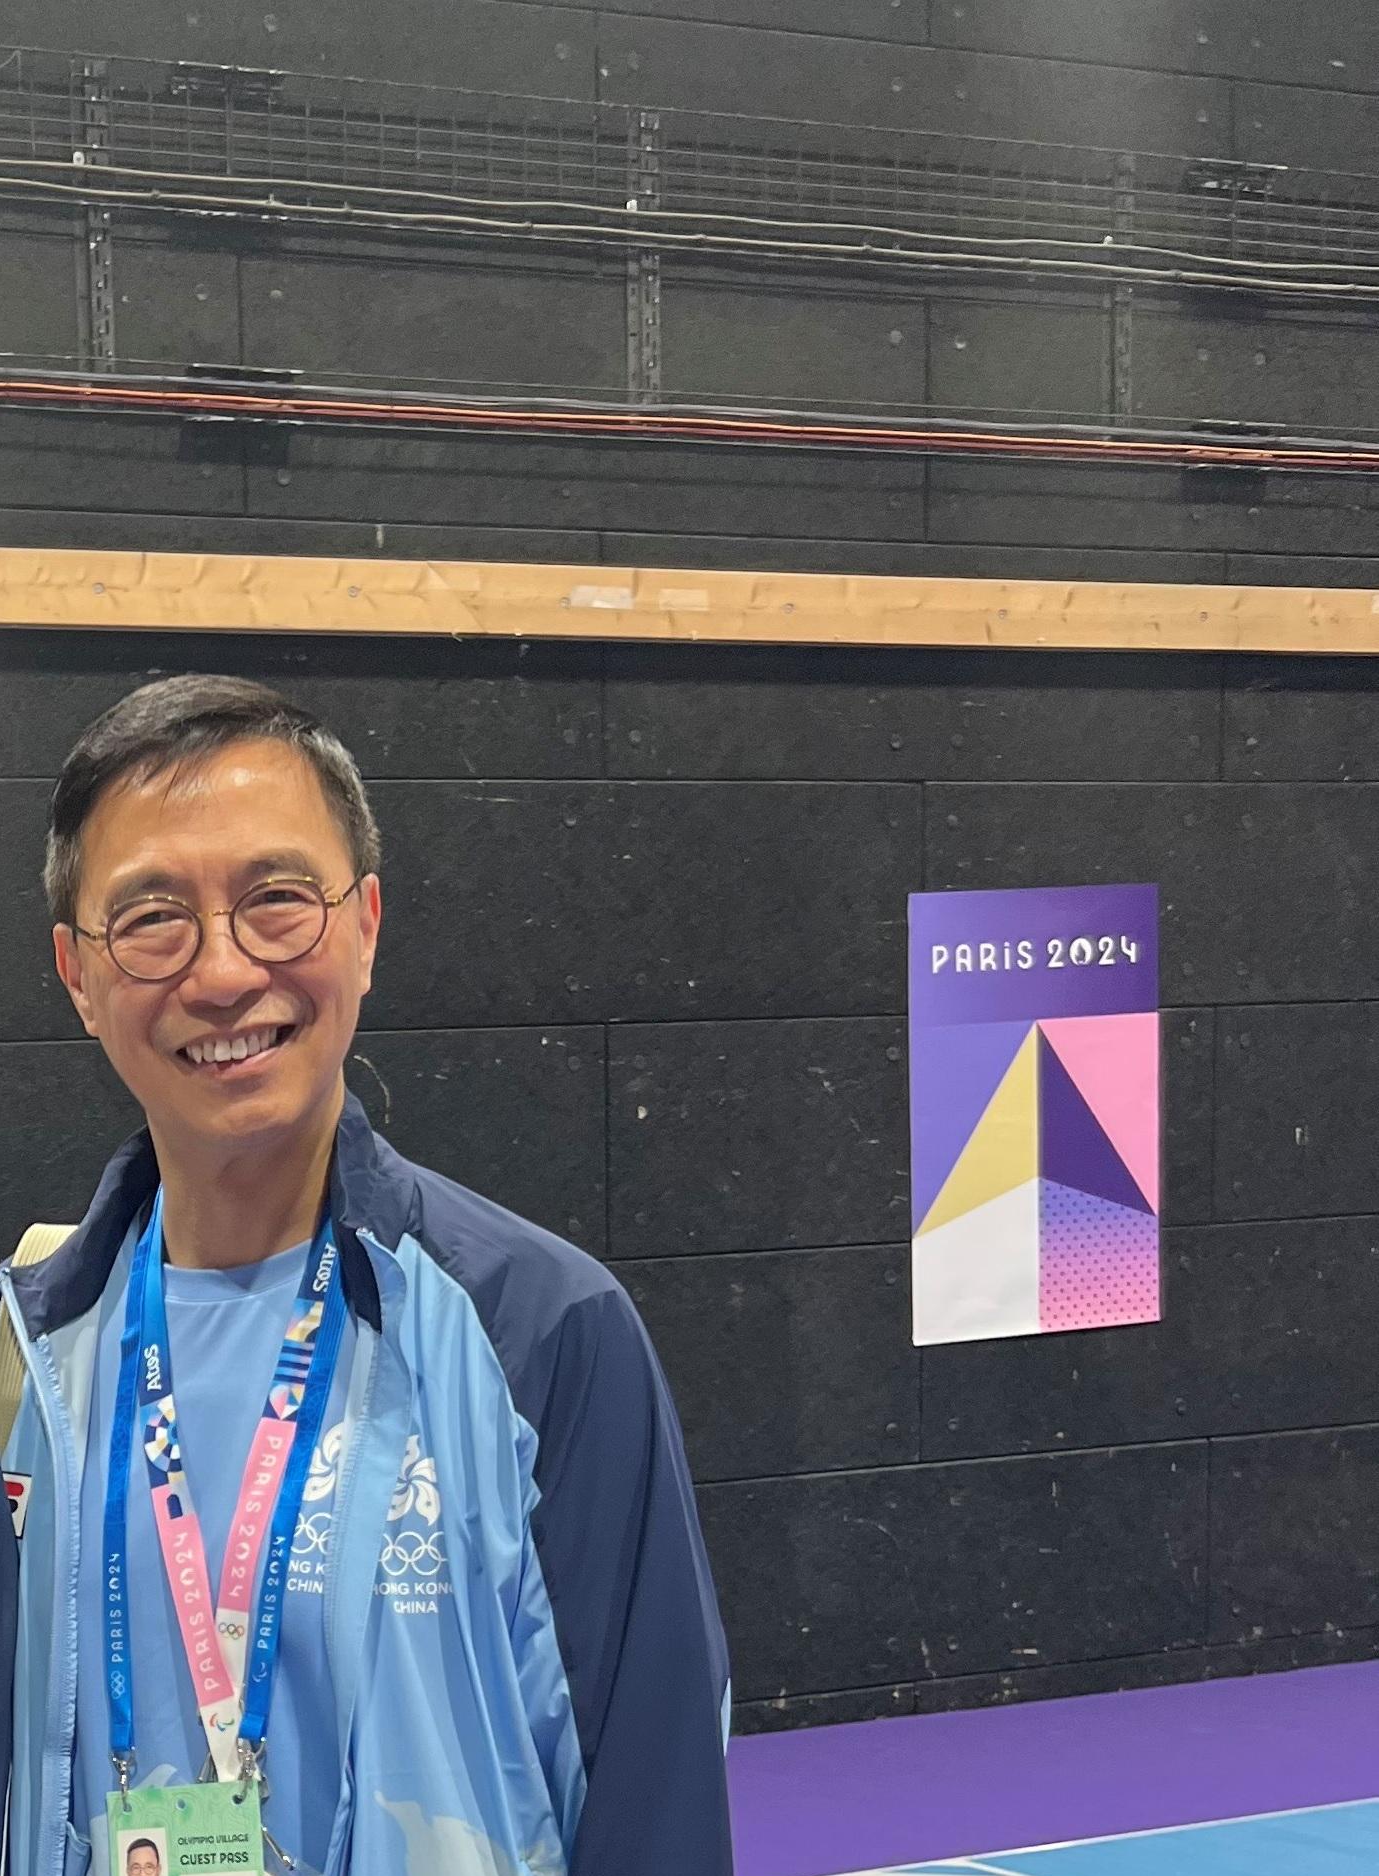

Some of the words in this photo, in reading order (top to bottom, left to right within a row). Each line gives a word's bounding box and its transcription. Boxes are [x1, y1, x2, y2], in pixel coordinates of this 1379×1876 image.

[1047, 935, 1137, 968] 2024
[143, 1343, 162, 1392] Atos
[172, 1530, 203, 1604] 2024
[228, 1523, 256, 1598] 2024
[268, 1536, 286, 1585] 2024
[288, 1560, 312, 1574] NG
[108, 1553, 122, 1602] 2024
[287, 1578, 324, 1593] CHIN
[394, 1600, 438, 1614] CHINA
[216, 1833, 249, 1844] VILLAGE
[180, 1852, 216, 1866] GUEST
[219, 1851, 249, 1864] PASS
